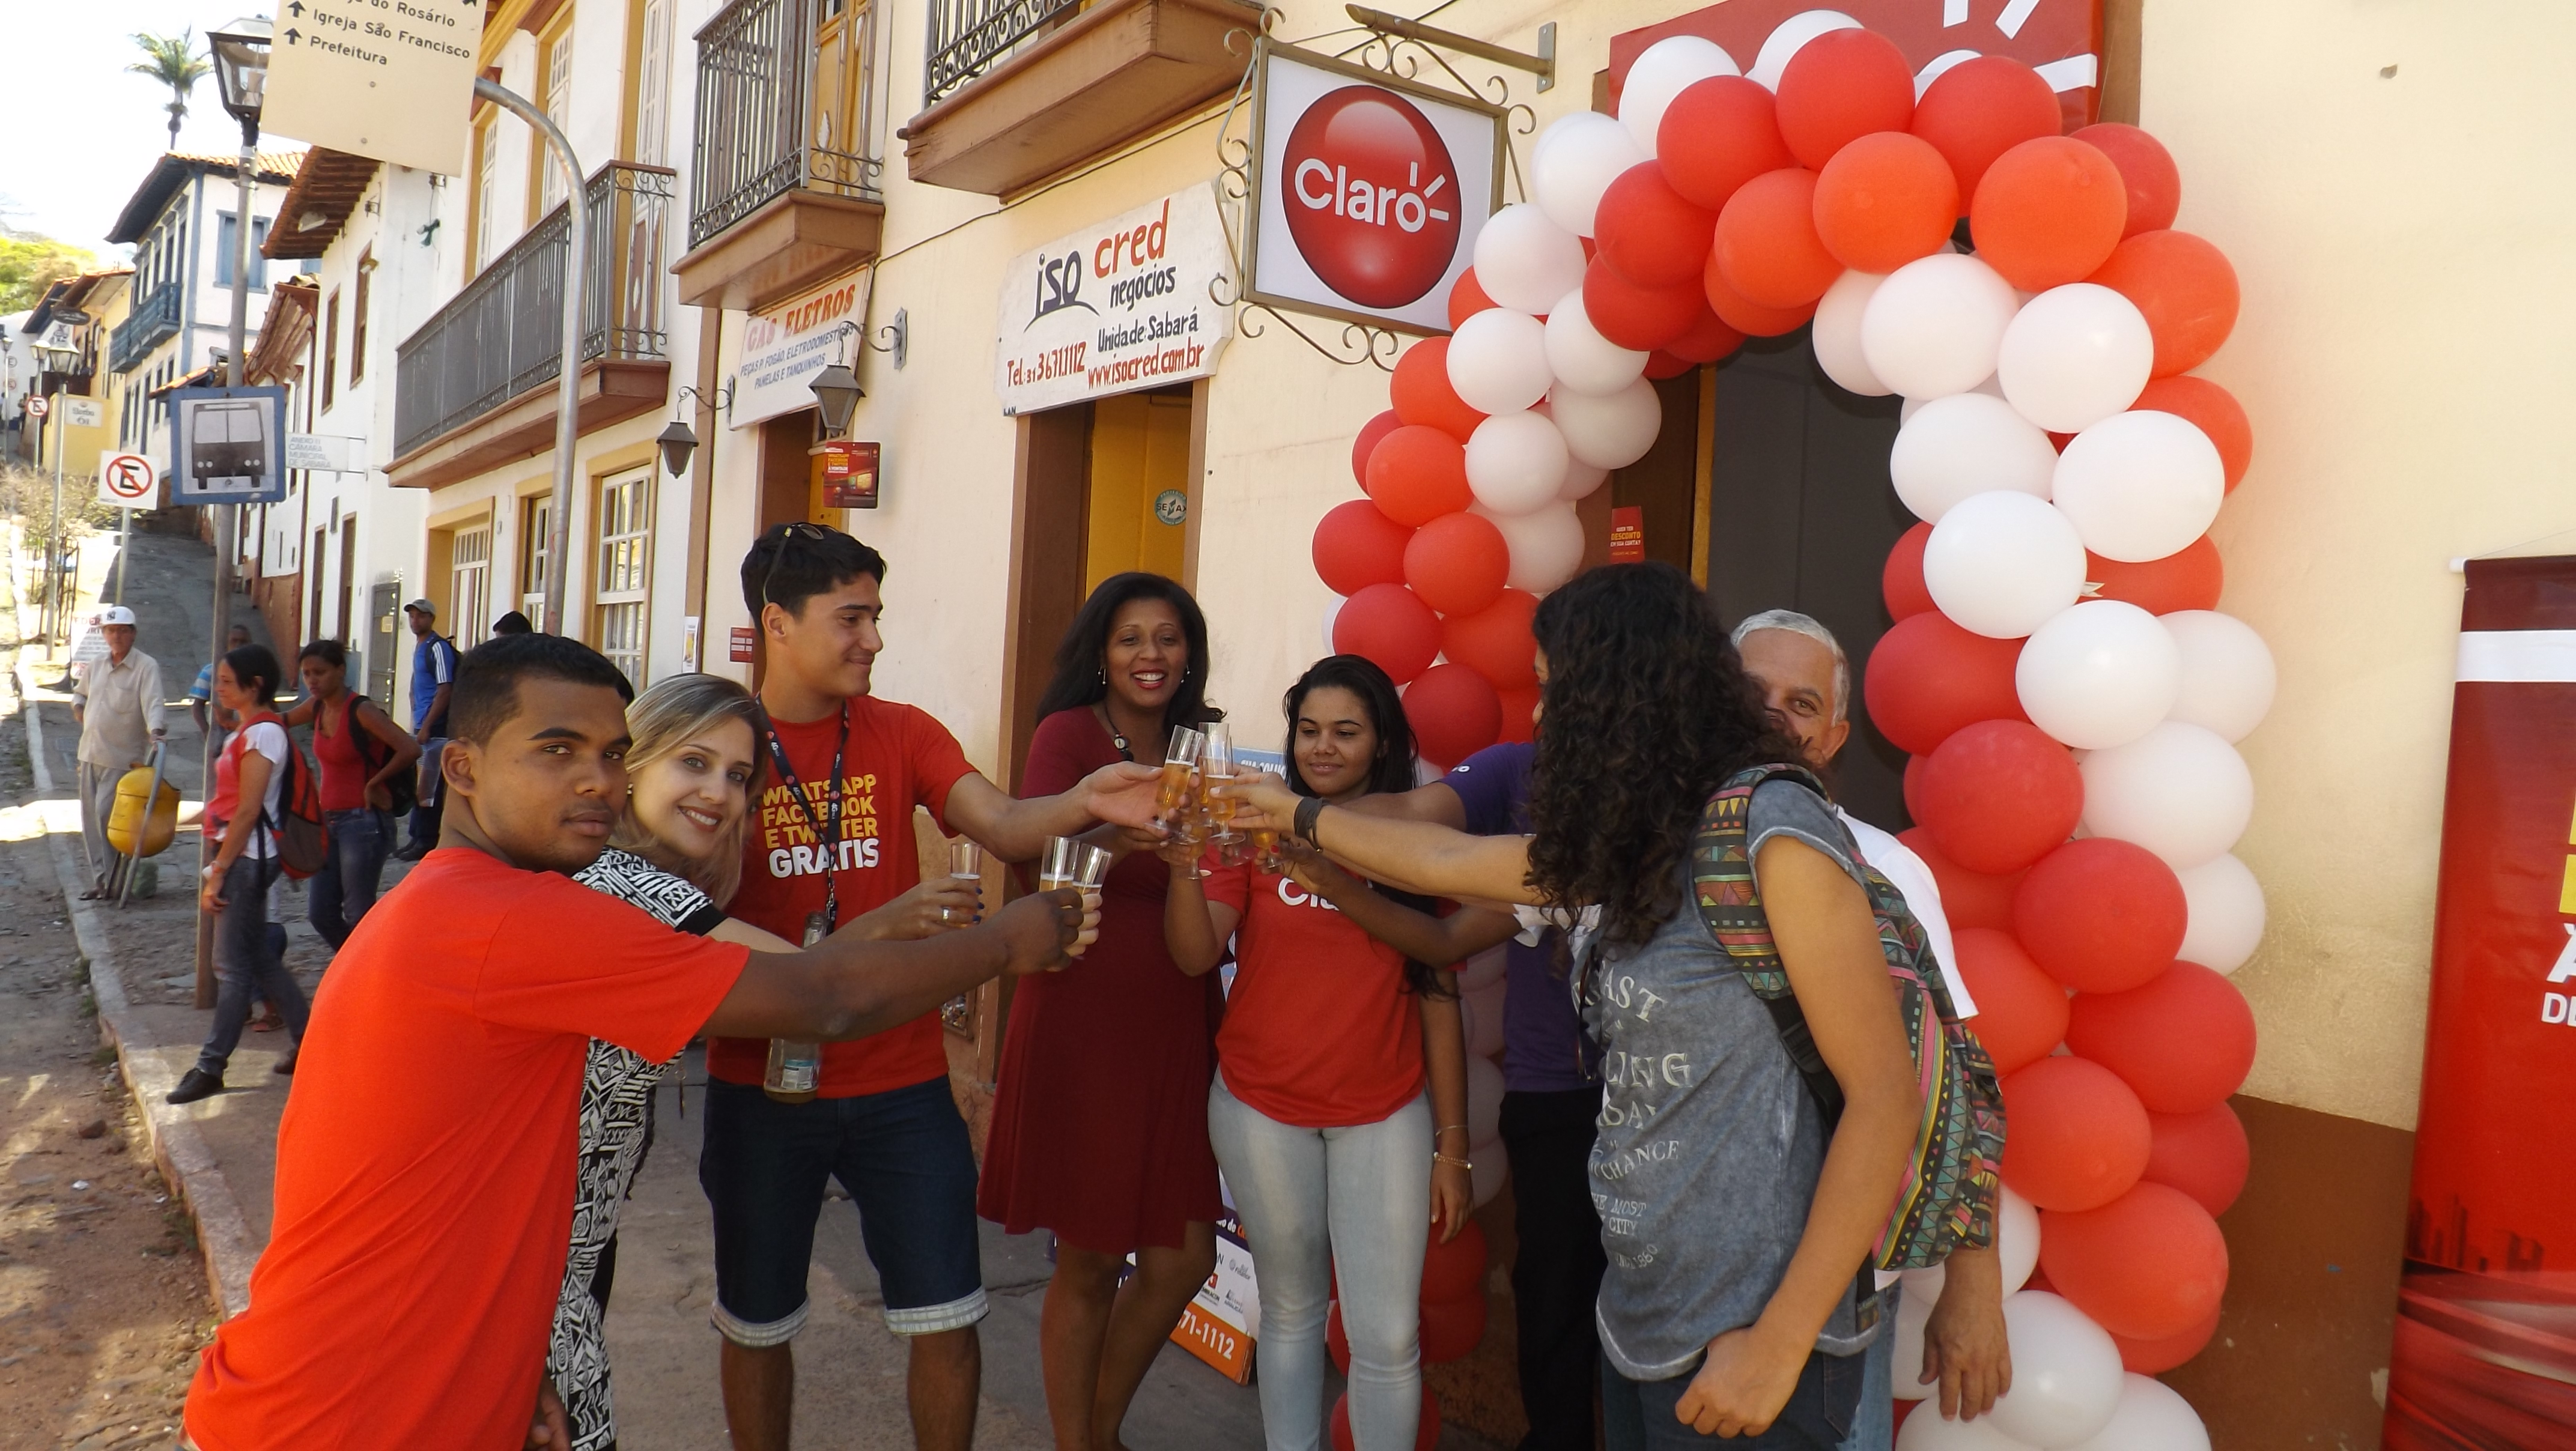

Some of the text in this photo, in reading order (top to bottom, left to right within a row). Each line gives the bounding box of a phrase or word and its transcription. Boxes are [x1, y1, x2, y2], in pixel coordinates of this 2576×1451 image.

[397, 2, 455, 27] Rosário
[310, 35, 387, 65] Prefeitura
[314, 9, 470, 59] Igreja São Francisco
[1295, 158, 1427, 232] Claro
[1094, 198, 1170, 279] cred
[1110, 262, 1176, 312] negócios
[747, 283, 855, 353] GÁS ELETROS
[1148, 305, 1198, 342] Sabará
[740, 362, 759, 378] PEÇAS
[755, 353, 826, 390] PANELAS E TANQUINHOS
[1088, 336, 1205, 390] www.isocred.com.br
[1611, 532, 1641, 541] DESCONTO
[762, 795, 876, 827] FACBOK
[764, 817, 879, 849] E TWTER
[768, 838, 879, 878] GRATIS
[1611, 1198, 1647, 1217] MOST
[1609, 1217, 1639, 1237] CITY
